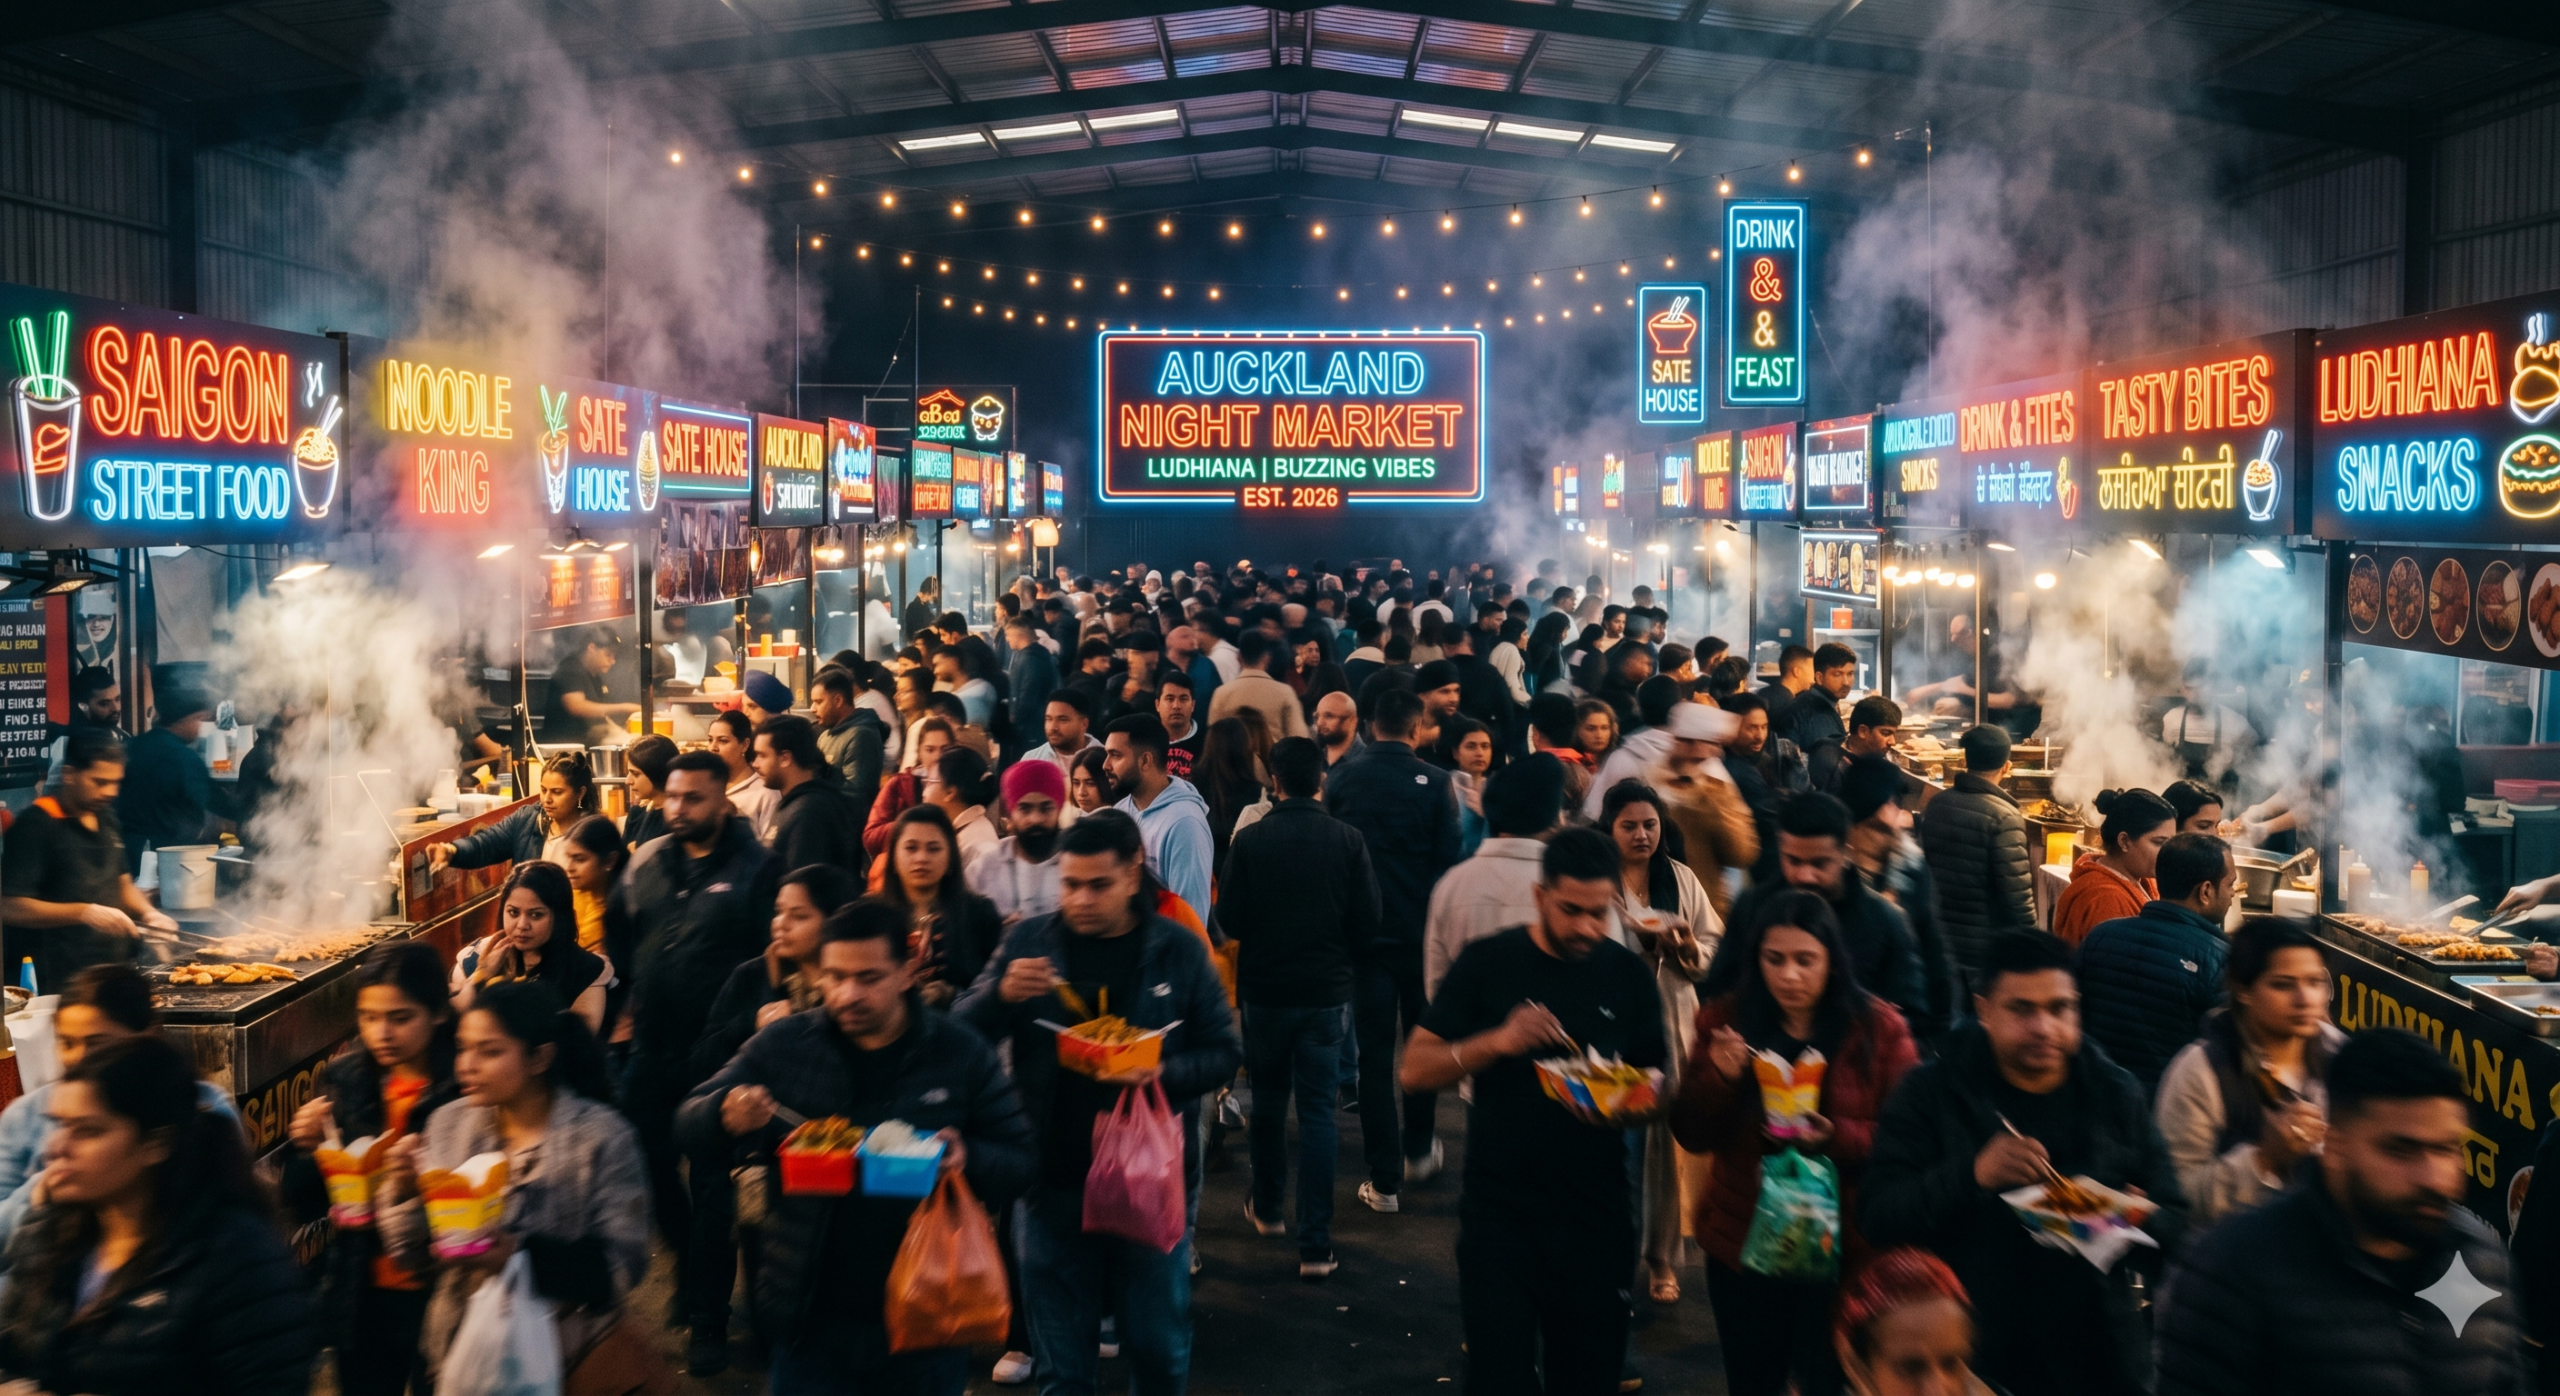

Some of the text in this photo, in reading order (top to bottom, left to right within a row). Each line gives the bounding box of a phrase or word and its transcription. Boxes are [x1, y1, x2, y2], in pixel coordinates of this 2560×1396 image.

[1736, 219, 1795, 248] DRINK
[1750, 257, 1782, 302] &
[1754, 310, 1776, 347] &
[92, 326, 288, 445] SAIGON
[1157, 351, 1425, 395] AUCKLAND
[1652, 359, 1691, 383] SATE
[1735, 357, 1795, 387] FEAST
[2320, 331, 2499, 423] LUDHIANA
[388, 359, 512, 439] NOODLE
[1645, 388, 1698, 412] HOUSE
[2100, 355, 2271, 439] TASTY BITES
[578, 395, 628, 456] SATE
[1120, 404, 1463, 447] NIGHT MARKET
[1961, 401, 2007, 452] DRINK
[2009, 399, 2023, 448] &
[2025, 390, 2075, 446] FITES
[662, 420, 748, 477] SATE HOUSE
[765, 425, 823, 471] AUCKLAND
[1147, 457, 1256, 478] LUDHIANA
[1273, 456, 1367, 478] BUZZING
[1372, 456, 1436, 478] VIBES
[1747, 433, 1783, 478] SAIGON
[93, 459, 291, 521] STREET FOOD
[418, 447, 490, 515] KING
[575, 466, 631, 512] HOUSE
[1243, 487, 1338, 507] EST. 2026
[2338, 437, 2476, 513] SNACKS
